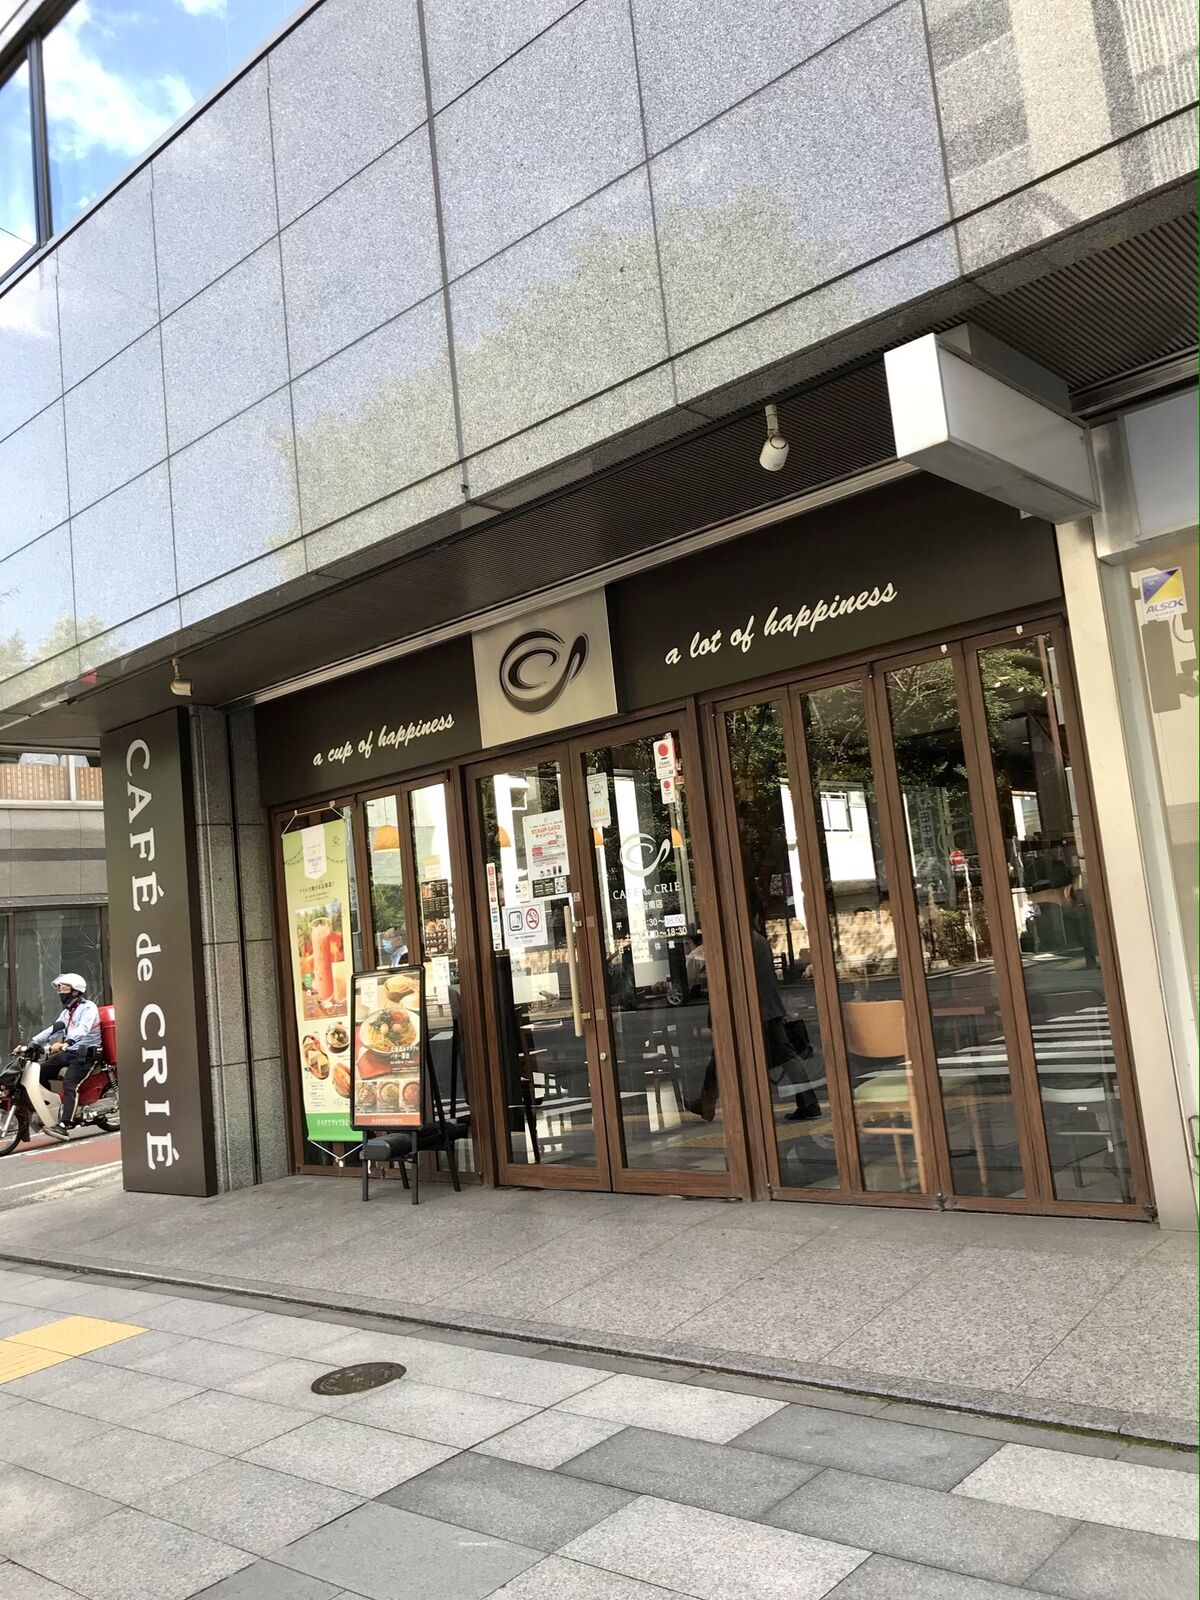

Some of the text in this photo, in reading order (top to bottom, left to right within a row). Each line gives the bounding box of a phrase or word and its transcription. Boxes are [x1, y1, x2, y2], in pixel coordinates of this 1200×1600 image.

[665, 582, 898, 665] a lot of happiness
[1146, 598, 1185, 615] ALSOK
[312, 713, 455, 766] a cup of happiness
[125, 738, 180, 1171] CAFÉ de CRIÉ
